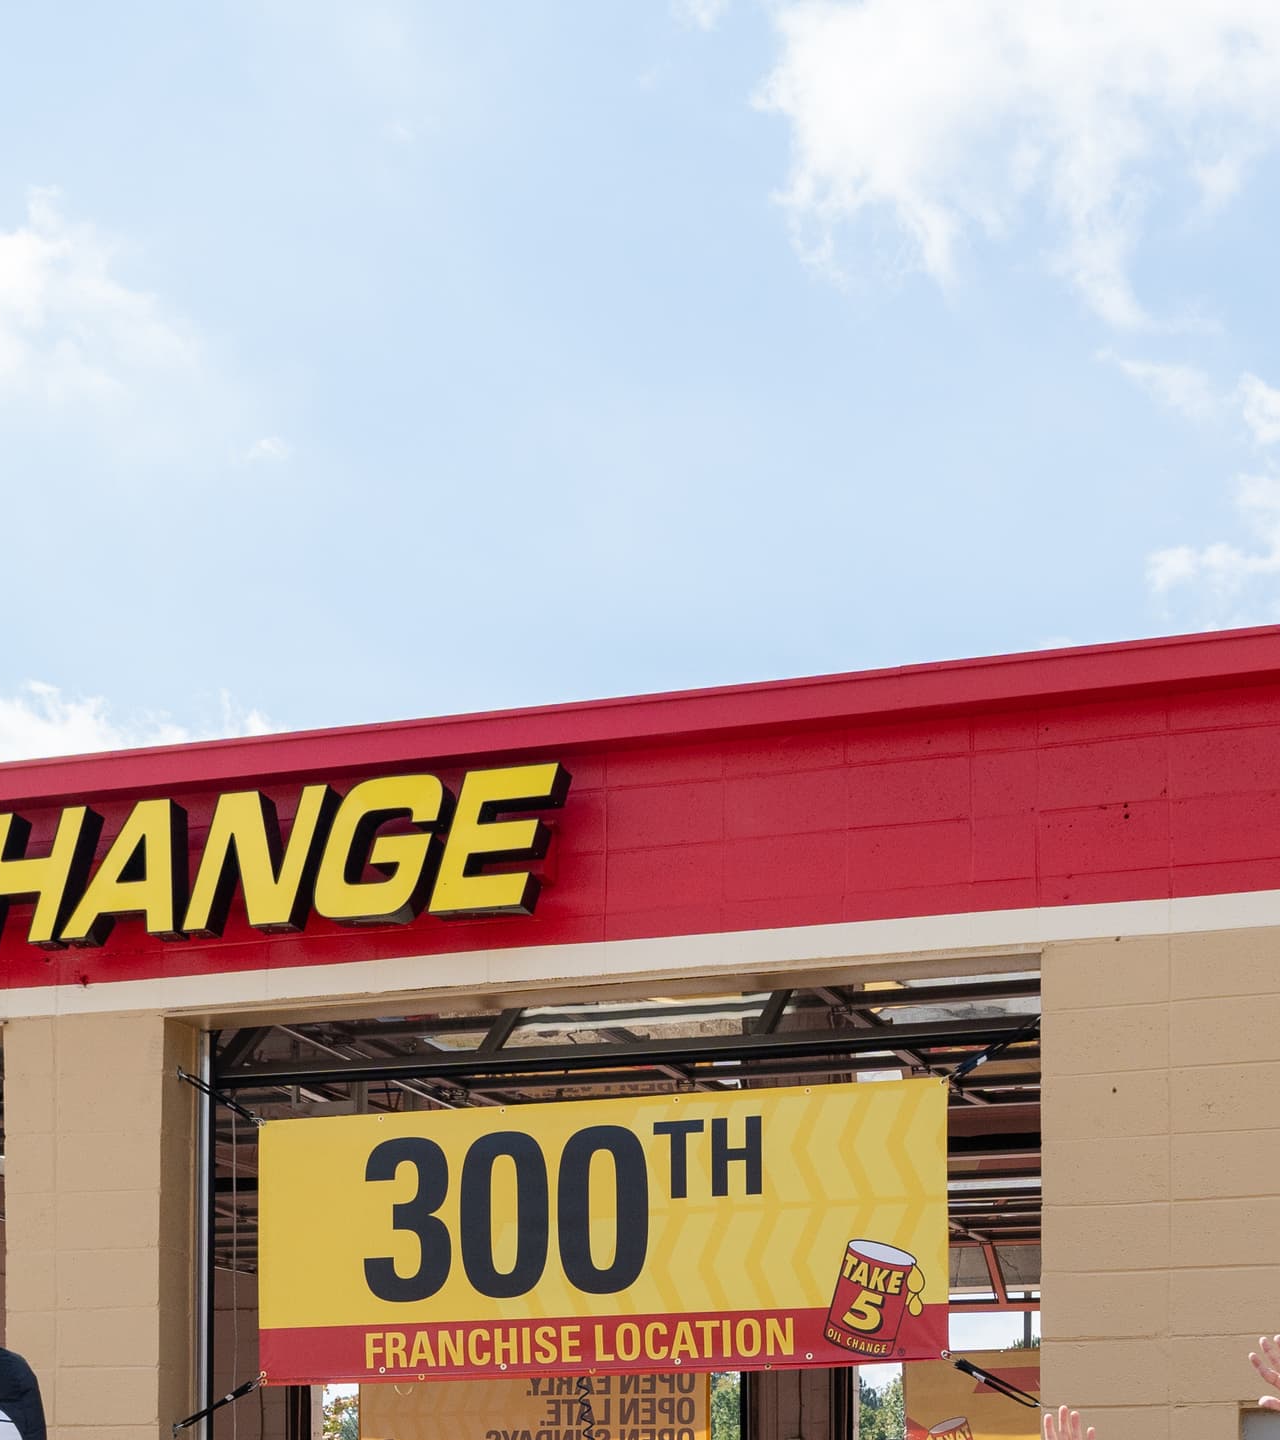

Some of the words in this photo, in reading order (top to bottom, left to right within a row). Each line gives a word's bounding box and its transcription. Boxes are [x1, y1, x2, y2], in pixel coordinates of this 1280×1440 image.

[364, 1116, 762, 1302] 300TH
[843, 1253, 905, 1295] TAKE
[842, 1289, 885, 1334] 5
[365, 1323, 582, 1369] FRANCHISE
[594, 1317, 795, 1363] LOCATION
[827, 1328, 841, 1343] OIL
[846, 1337, 887, 1354] CHANGE
